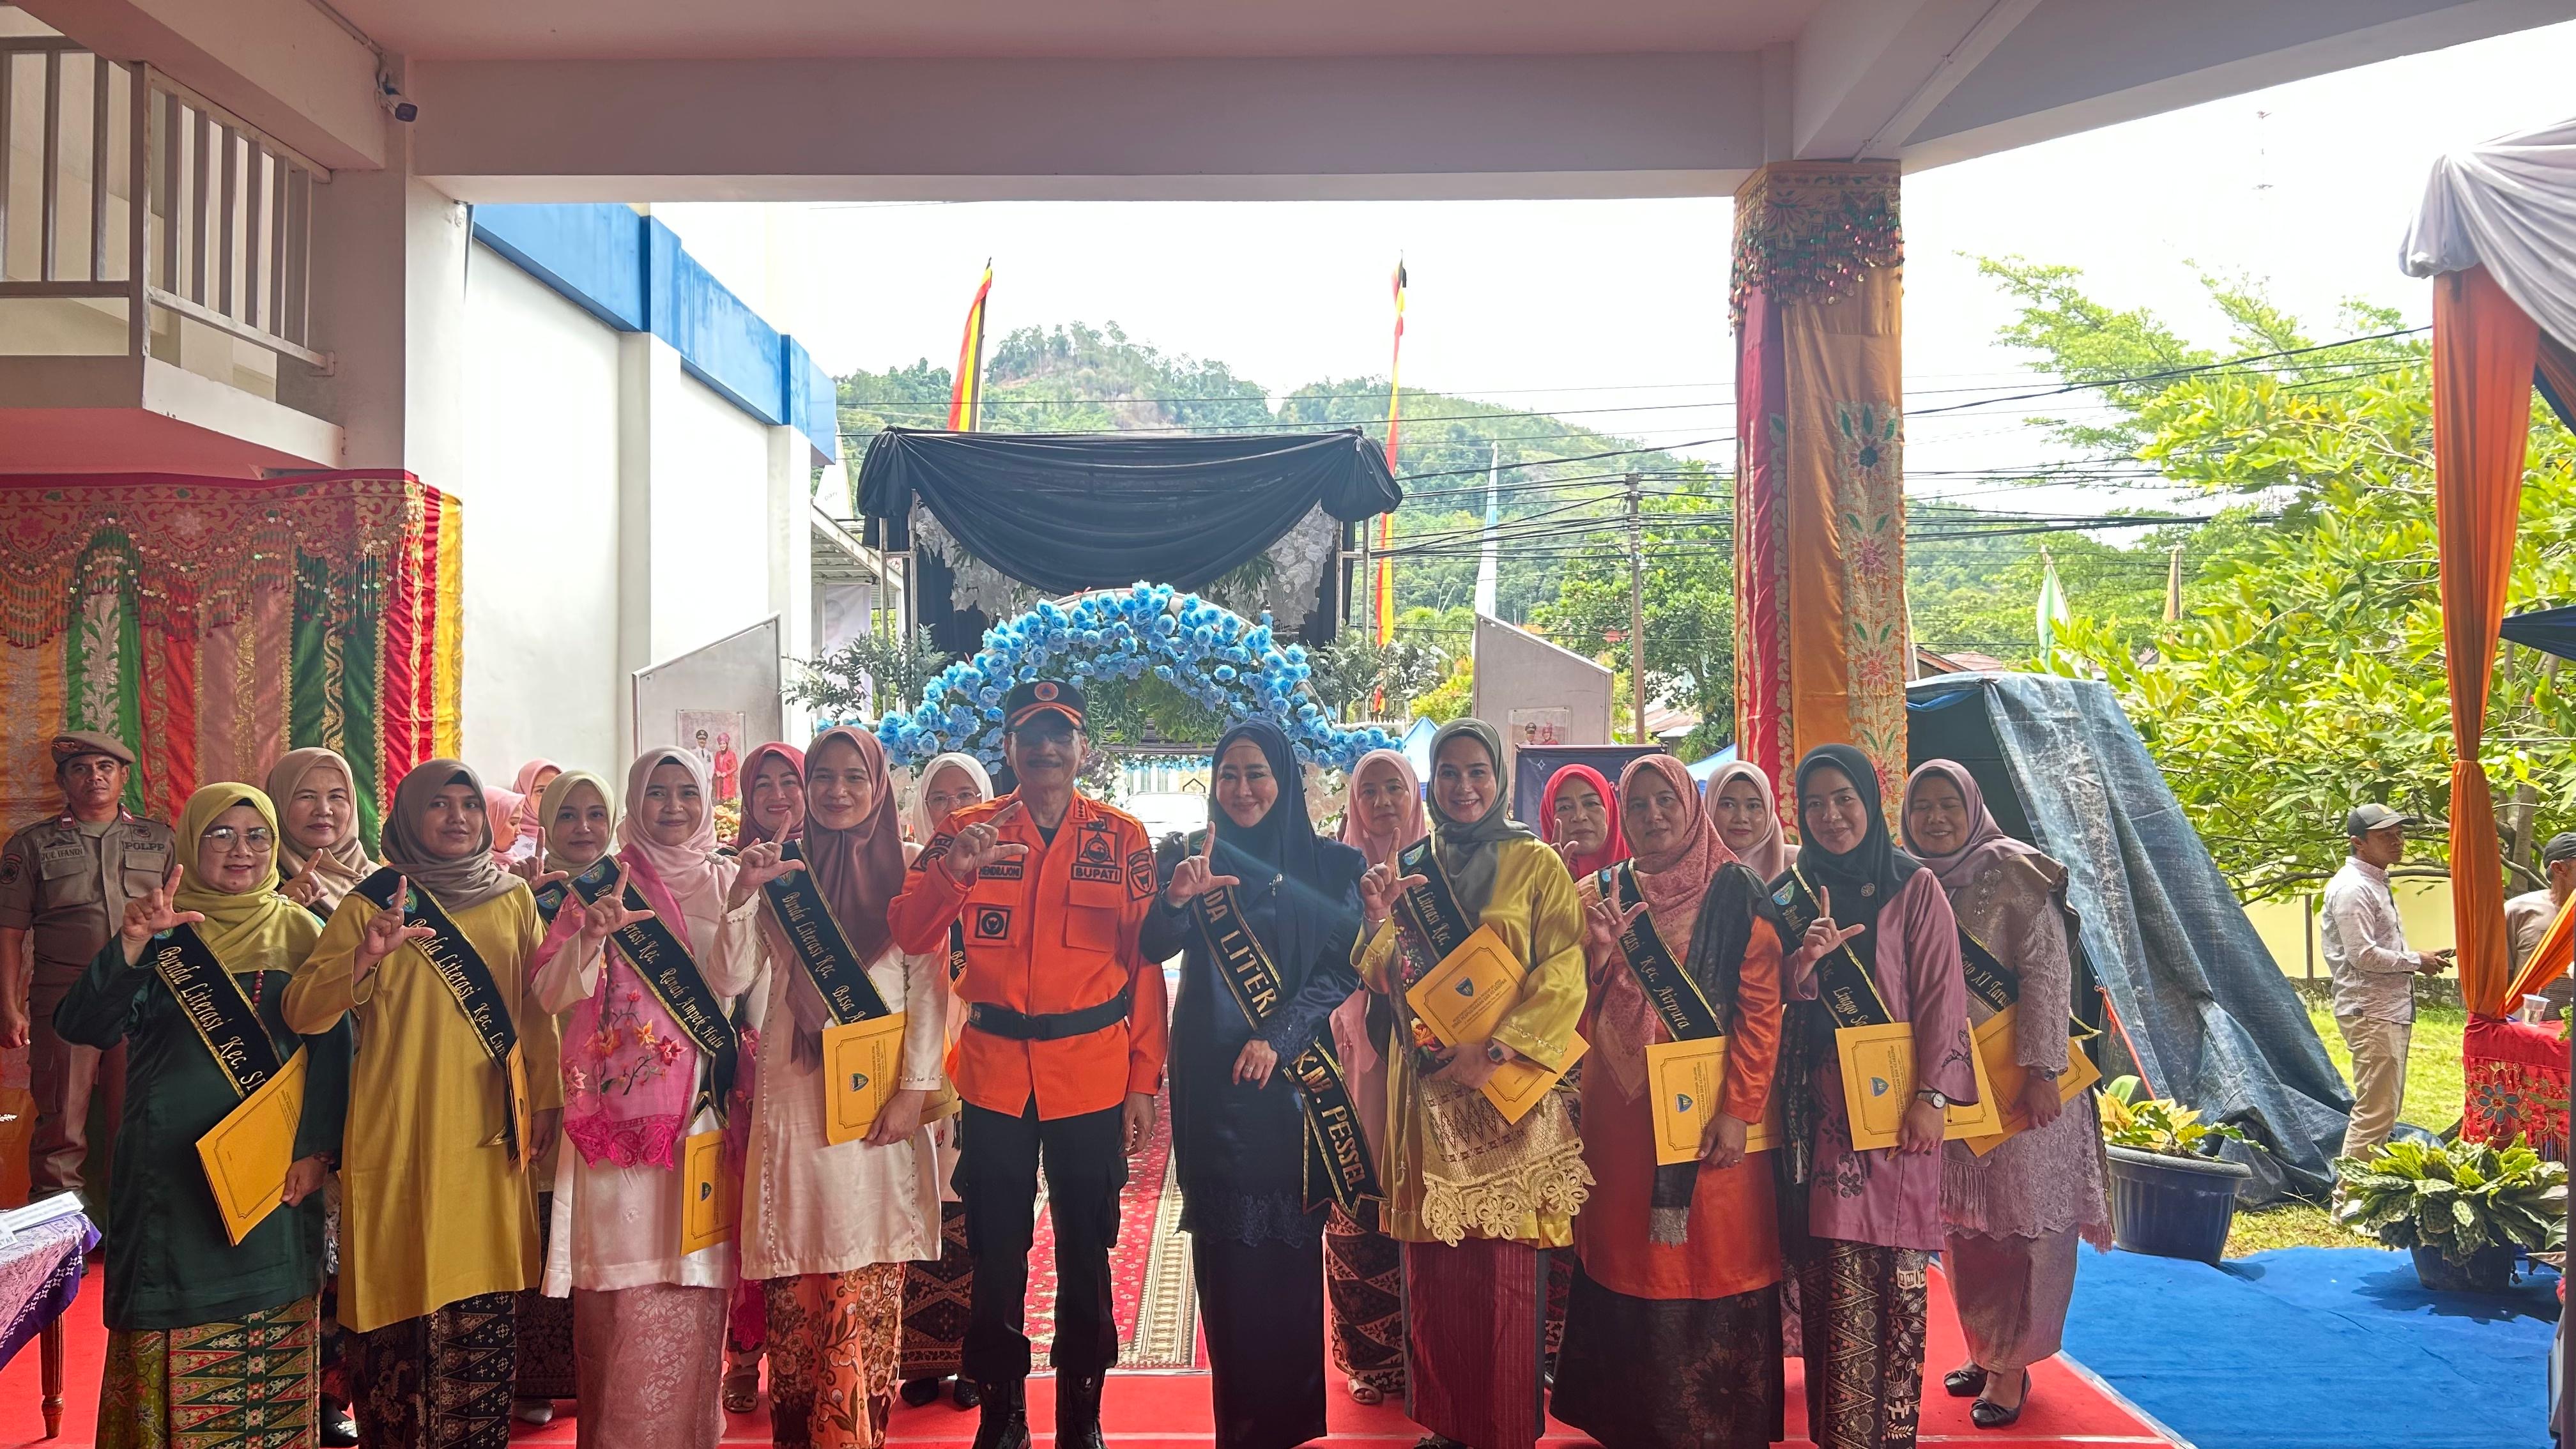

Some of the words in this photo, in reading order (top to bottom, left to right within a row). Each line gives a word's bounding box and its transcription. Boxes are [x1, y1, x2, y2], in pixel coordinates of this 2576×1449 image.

[1075, 867, 1118, 880] BUPATI
[782, 891, 811, 922] Bunda
[796, 921, 830, 958] Literasi
[157, 946, 201, 985] Bunda
[180, 983, 234, 1032] Literasi
[408, 918, 448, 956] Bnda
[436, 954, 482, 1000] Literasi
[473, 1002, 493, 1031] Kec.
[622, 923, 652, 946] erasi
[659, 967, 690, 999] Ranah
[676, 997, 711, 1032] Ampek
[700, 1025, 726, 1049] Hulu
[1640, 954, 1660, 983] Kec.
[1653, 985, 1692, 1030] Airpura
[1832, 986, 1859, 1015] Linggo
[1970, 970, 1993, 987] XI
[1321, 1105, 1366, 1193] PESSEL
